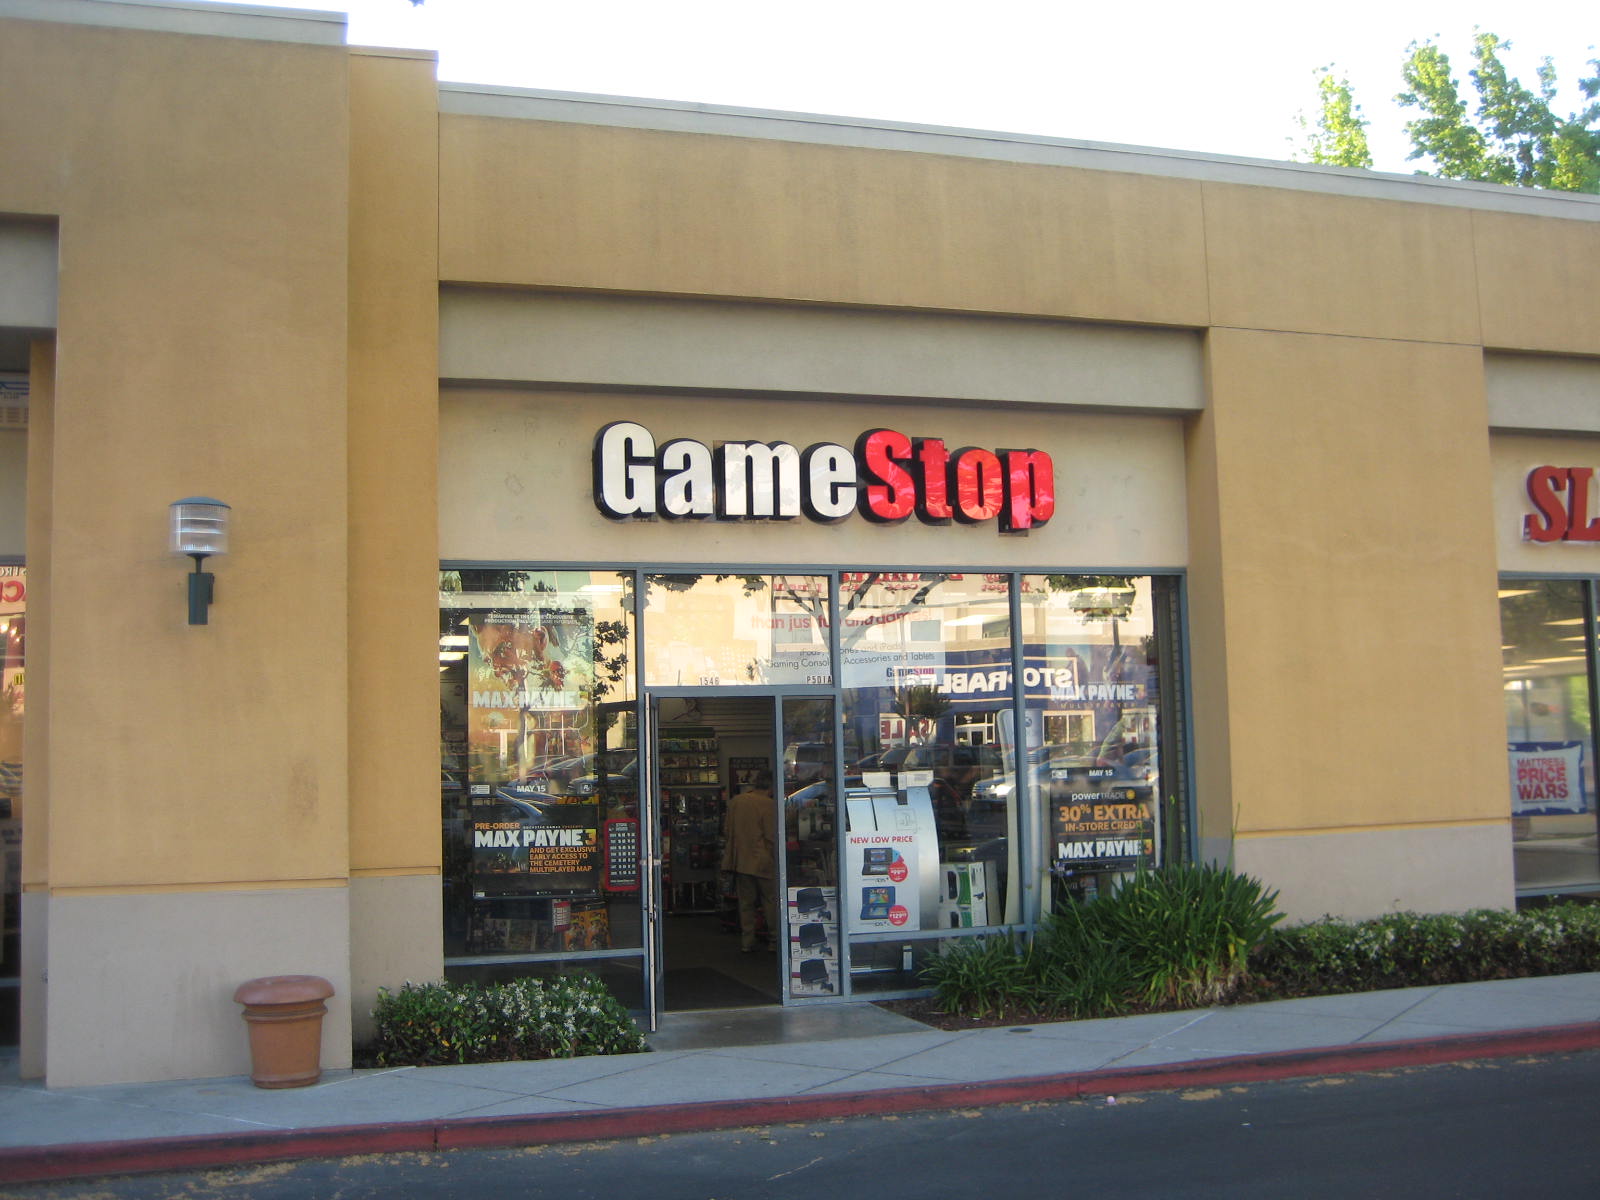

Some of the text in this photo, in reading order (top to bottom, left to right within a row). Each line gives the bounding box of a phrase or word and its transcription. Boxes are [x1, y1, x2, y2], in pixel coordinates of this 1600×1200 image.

[593, 420, 1056, 536] GameStop
[788, 615, 814, 632] jus
[843, 654, 892, 665] Accessories
[893, 653, 908, 662] and
[1088, 684, 1135, 701] PAYNE
[1089, 769, 1104, 777] MAY
[1517, 767, 1567, 783] PRICE
[516, 784, 546, 793] MAY 15
[1517, 783, 1569, 800] WARS
[1059, 804, 1151, 822] 30% EXTRA
[474, 821, 520, 830] PRE-ORDER
[1065, 822, 1110, 832] IN-STORE
[474, 828, 597, 848] MAX PAYNE 3
[850, 835, 913, 844] NEW LOW PRICE
[560, 845, 597, 853] EXCLUSIVE
[1058, 841, 1095, 859] MAX
[1096, 839, 1142, 857] PAYNE
[551, 852, 577, 860] ACCESS
[529, 859, 580, 867] THE CEMETERY
